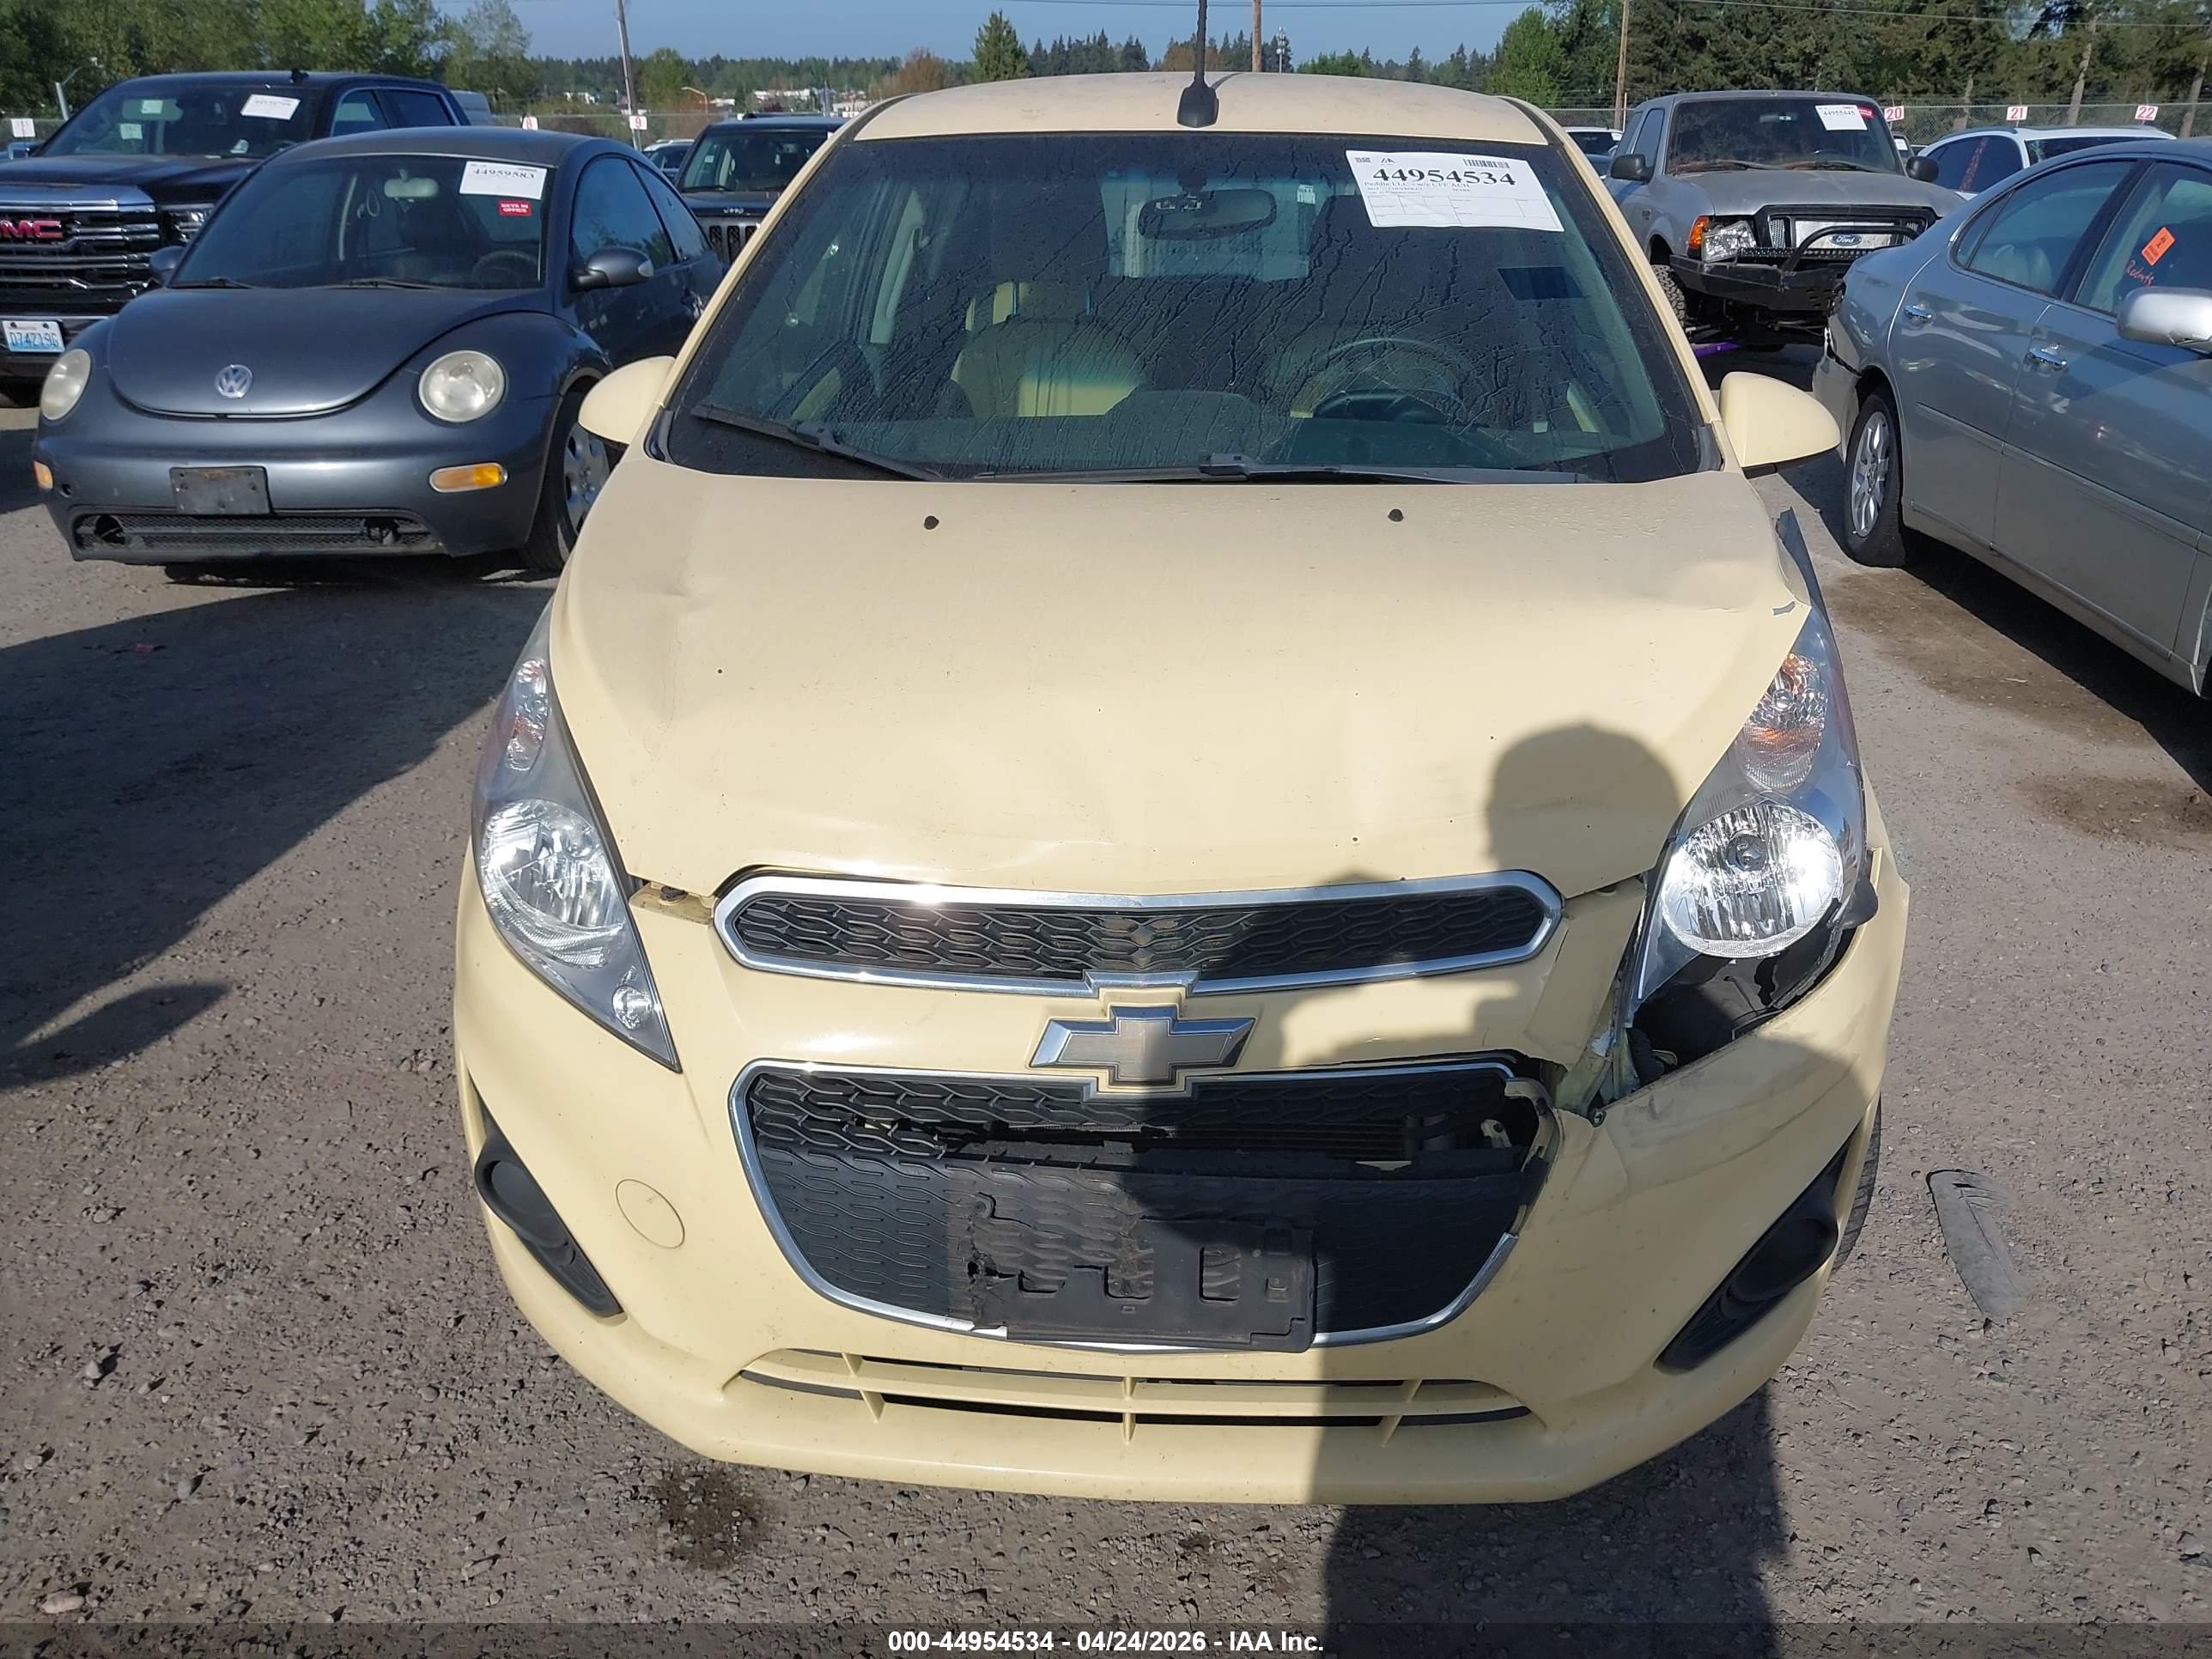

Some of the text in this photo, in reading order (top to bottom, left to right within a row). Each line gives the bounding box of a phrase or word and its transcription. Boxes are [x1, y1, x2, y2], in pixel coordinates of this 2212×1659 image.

[1886, 106, 1903, 120] 20
[2010, 106, 2024, 119] 21
[2136, 106, 2156, 119] 22
[635, 117, 642, 128] 9
[1372, 167, 1517, 185] 44954534
[1836, 234, 1856, 243] Ford
